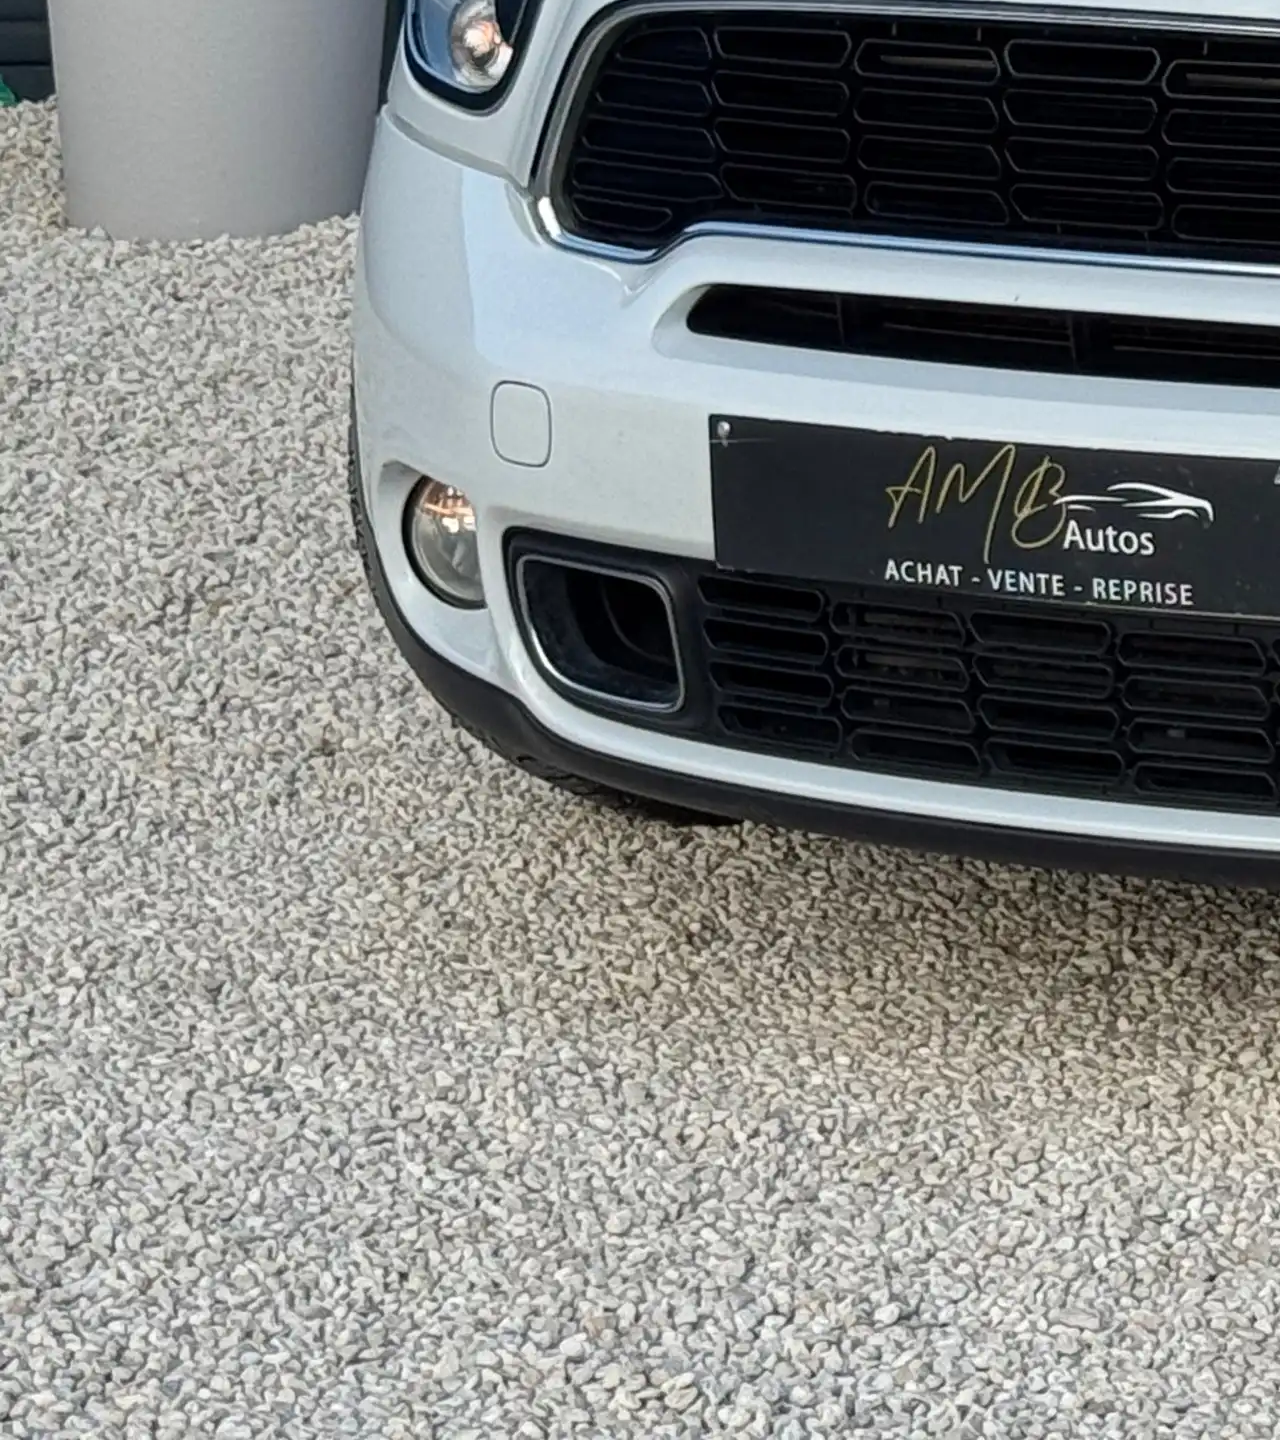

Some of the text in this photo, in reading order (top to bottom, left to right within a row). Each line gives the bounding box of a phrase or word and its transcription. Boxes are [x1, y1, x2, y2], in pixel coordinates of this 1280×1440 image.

[1063, 519, 1155, 557] Autos
[884, 559, 965, 588] ACHAT
[987, 568, 1066, 598] VENTE
[1092, 577, 1195, 607] REPRISE
